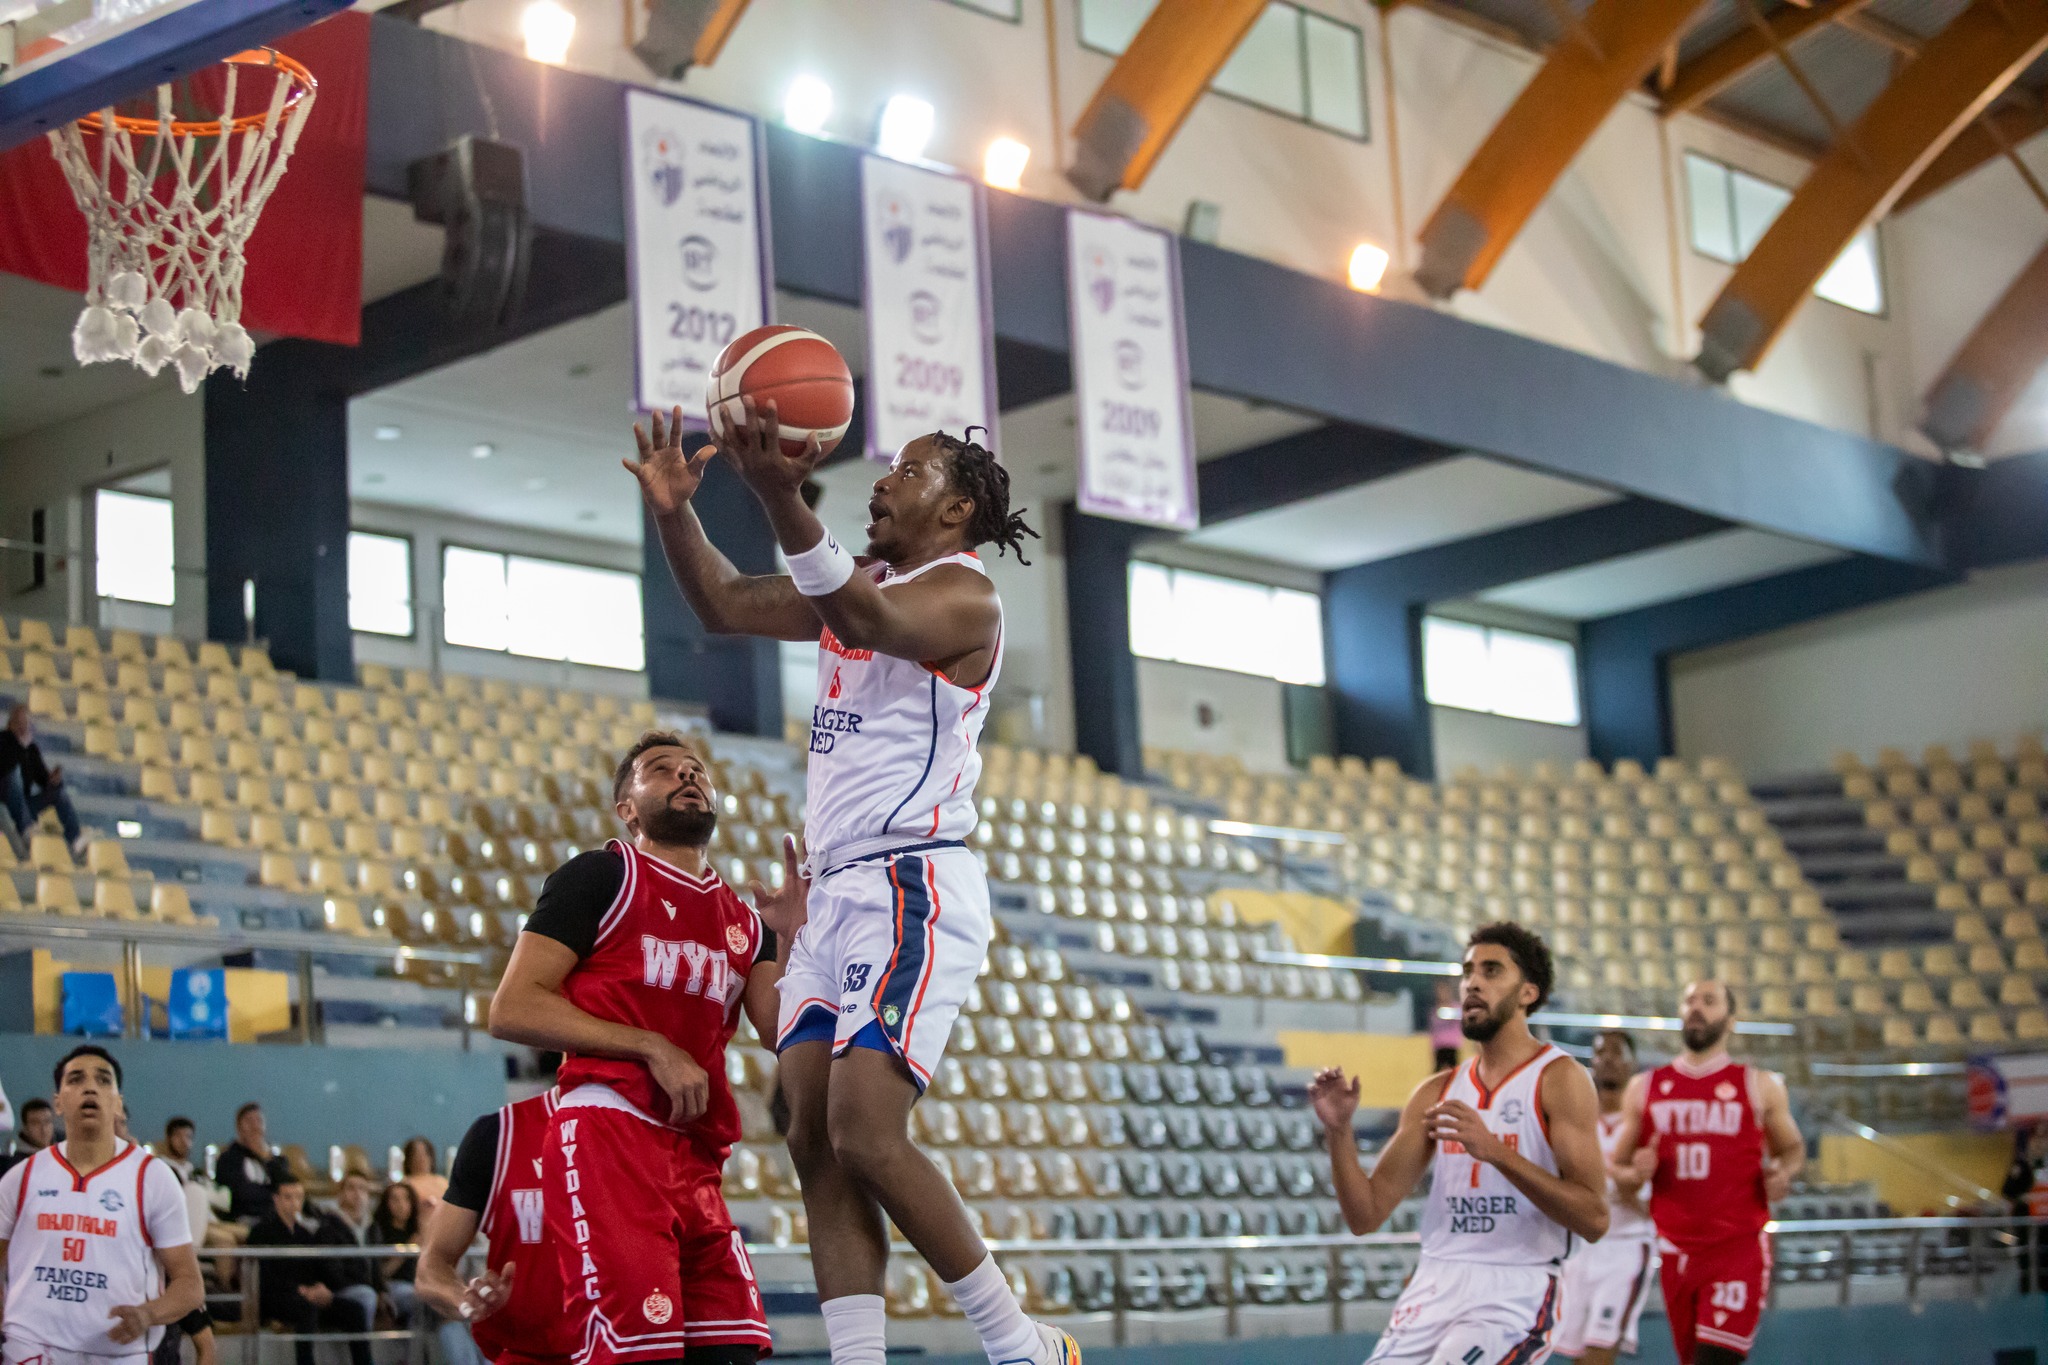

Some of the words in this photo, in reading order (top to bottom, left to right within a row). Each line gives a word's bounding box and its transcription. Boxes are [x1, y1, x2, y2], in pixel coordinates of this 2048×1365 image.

[897, 354, 962, 397] 2009
[809, 729, 836, 754] MED
[843, 963, 873, 994] 33
[840, 1003, 858, 1015] ive
[1649, 1099, 1743, 1136] WYDAD
[1676, 1142, 1711, 1180] 10
[1450, 1216, 1495, 1233] MED
[62, 1237, 86, 1262] 50
[34, 1266, 108, 1289] TANGER
[46, 1284, 88, 1303] MED
